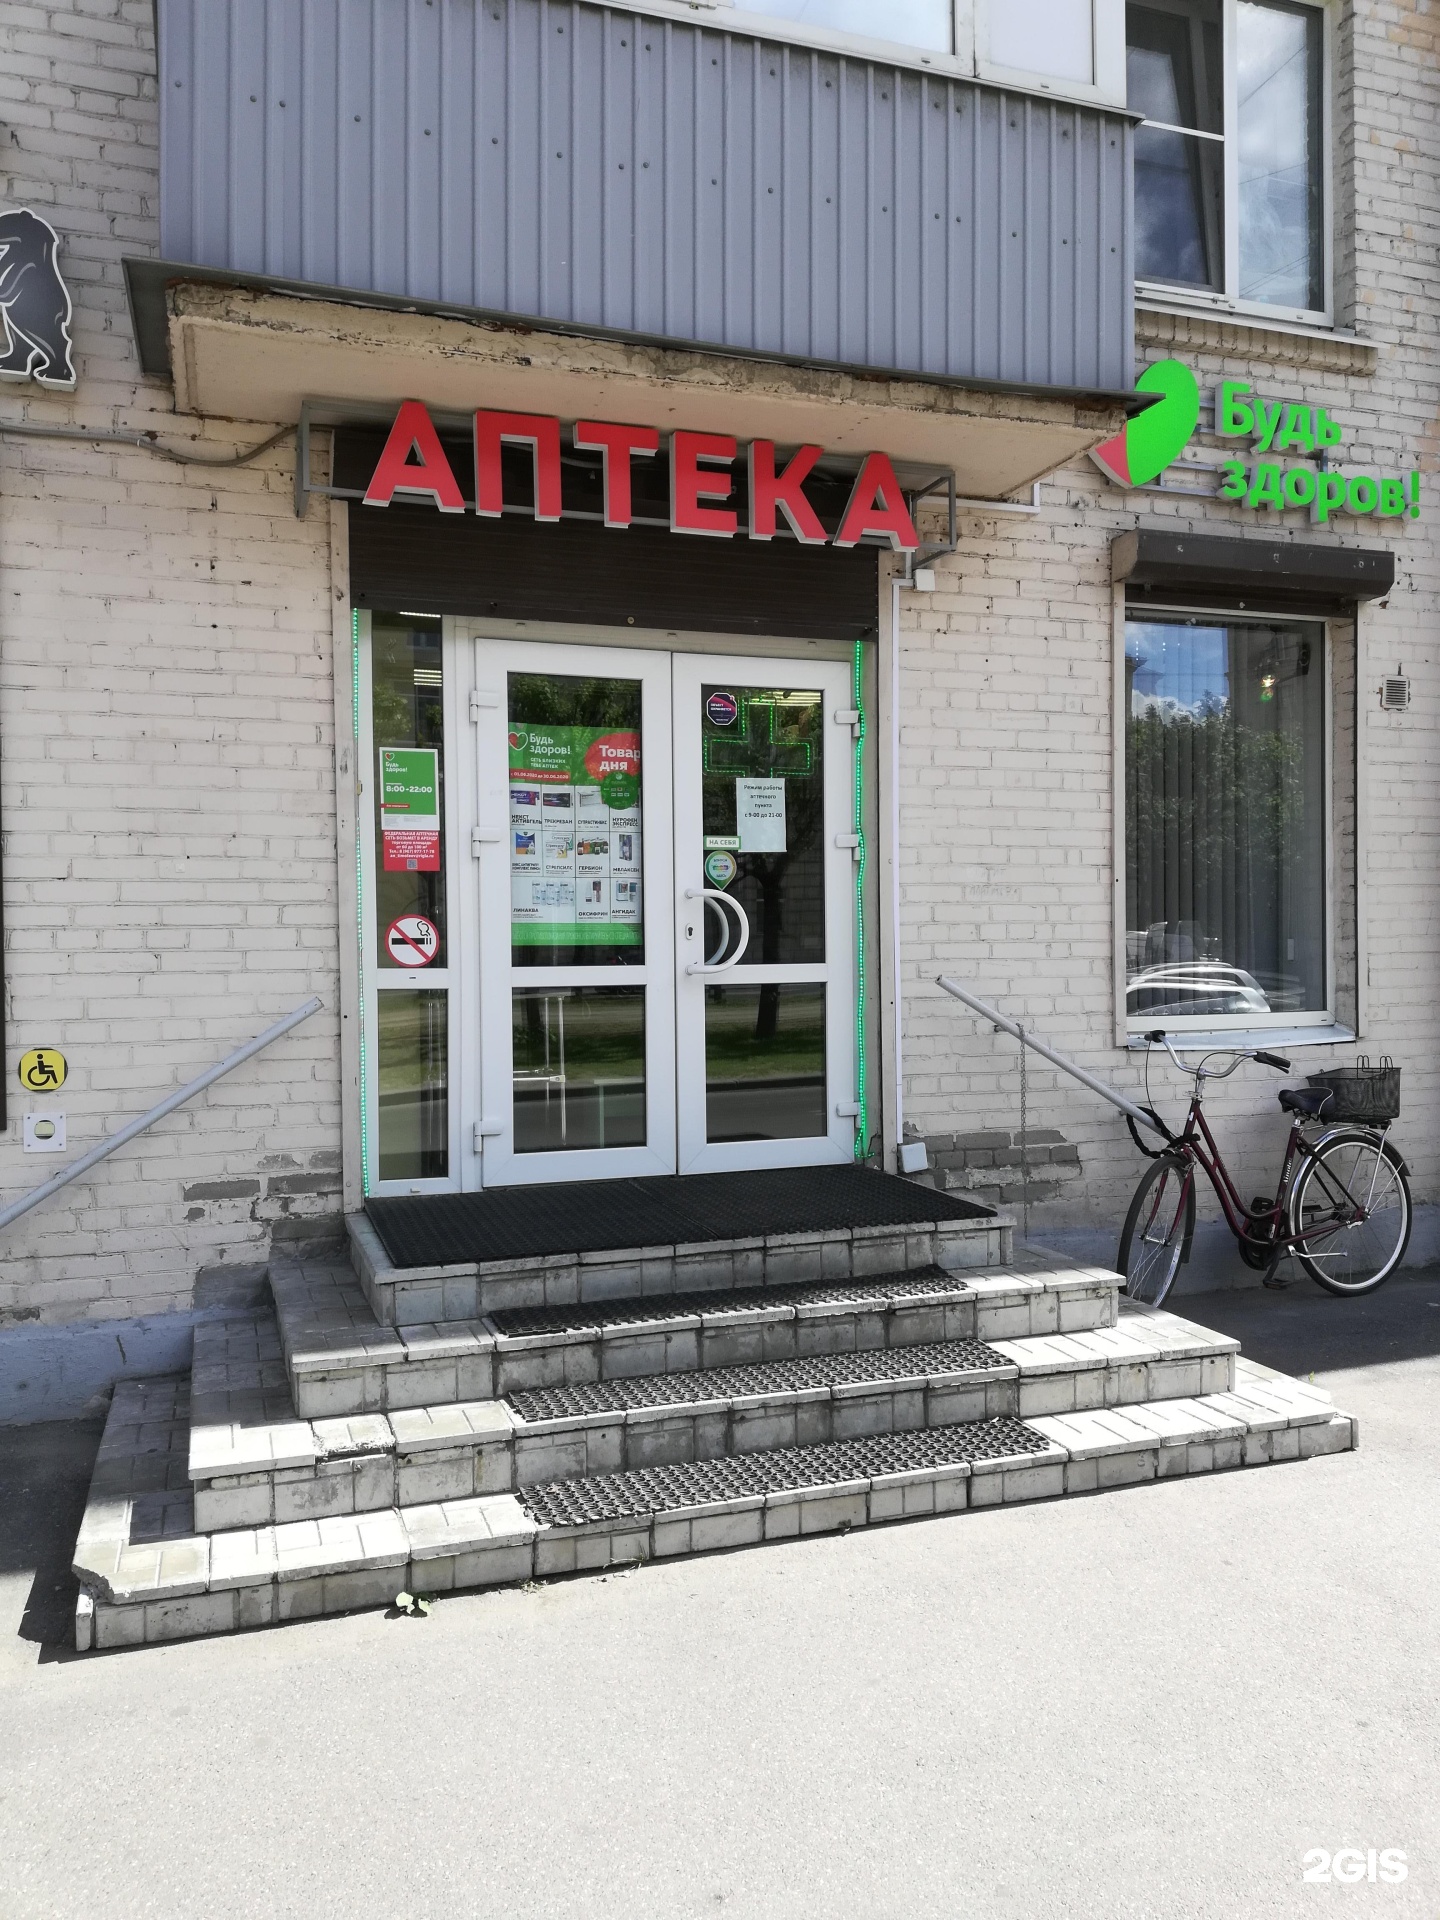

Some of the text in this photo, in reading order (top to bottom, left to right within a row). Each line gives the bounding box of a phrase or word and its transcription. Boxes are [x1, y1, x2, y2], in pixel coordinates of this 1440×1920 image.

[1215, 381, 1342, 453] Будь
[362, 400, 920, 552] АПТЕКА
[1216, 460, 1421, 524] здоров!
[530, 733, 554, 744] Будь
[529, 745, 571, 756] здоров!
[599, 745, 641, 761] Товар
[599, 761, 628, 772] дня
